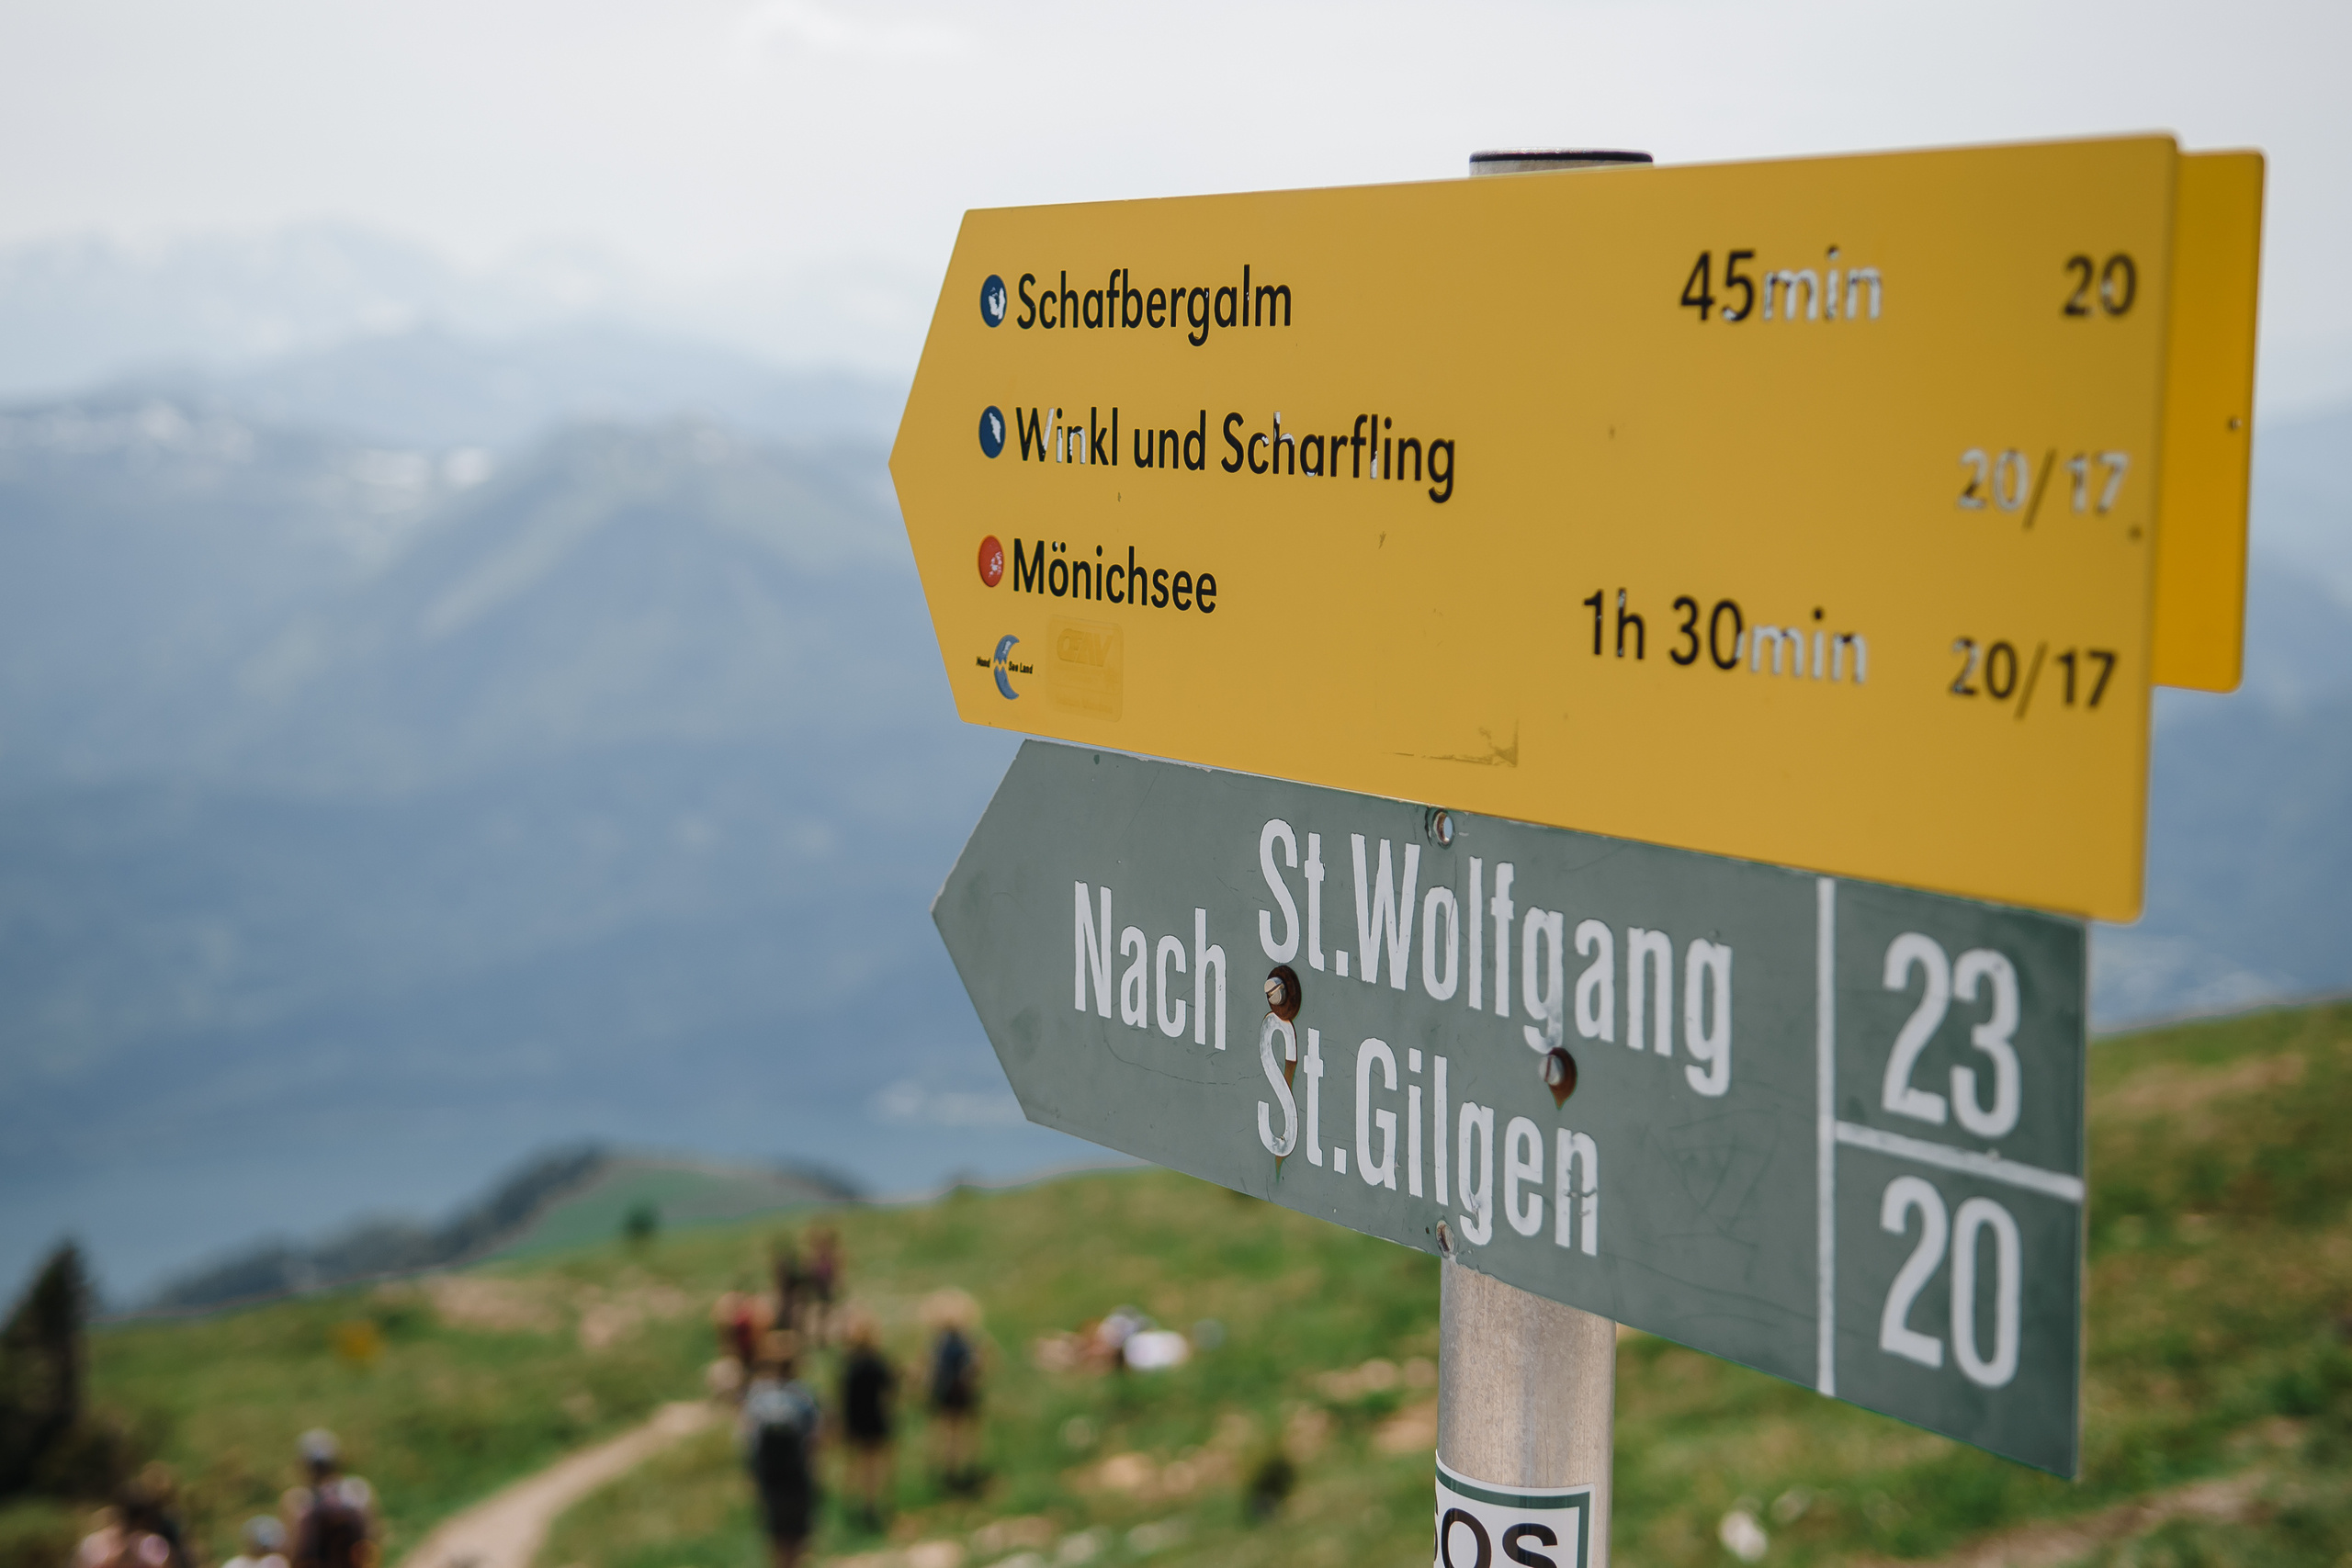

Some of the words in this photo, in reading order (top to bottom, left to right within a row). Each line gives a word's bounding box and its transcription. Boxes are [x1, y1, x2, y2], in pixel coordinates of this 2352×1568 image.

[1016, 264, 1292, 347] Schafbergalm
[2059, 252, 2137, 318] 20
[1015, 406, 1118, 466] Winkl
[1133, 410, 1206, 471] und
[1221, 411, 1456, 504] Scharfling
[1955, 447, 2132, 532] 20/17
[1012, 537, 1217, 615] Mönichsee
[1582, 586, 1645, 661] 1h
[1947, 636, 2119, 722] 20/17
[1074, 879, 1227, 1052] Nach
[1881, 931, 2021, 1139] 23
[1879, 1175, 2021, 1390] 20
